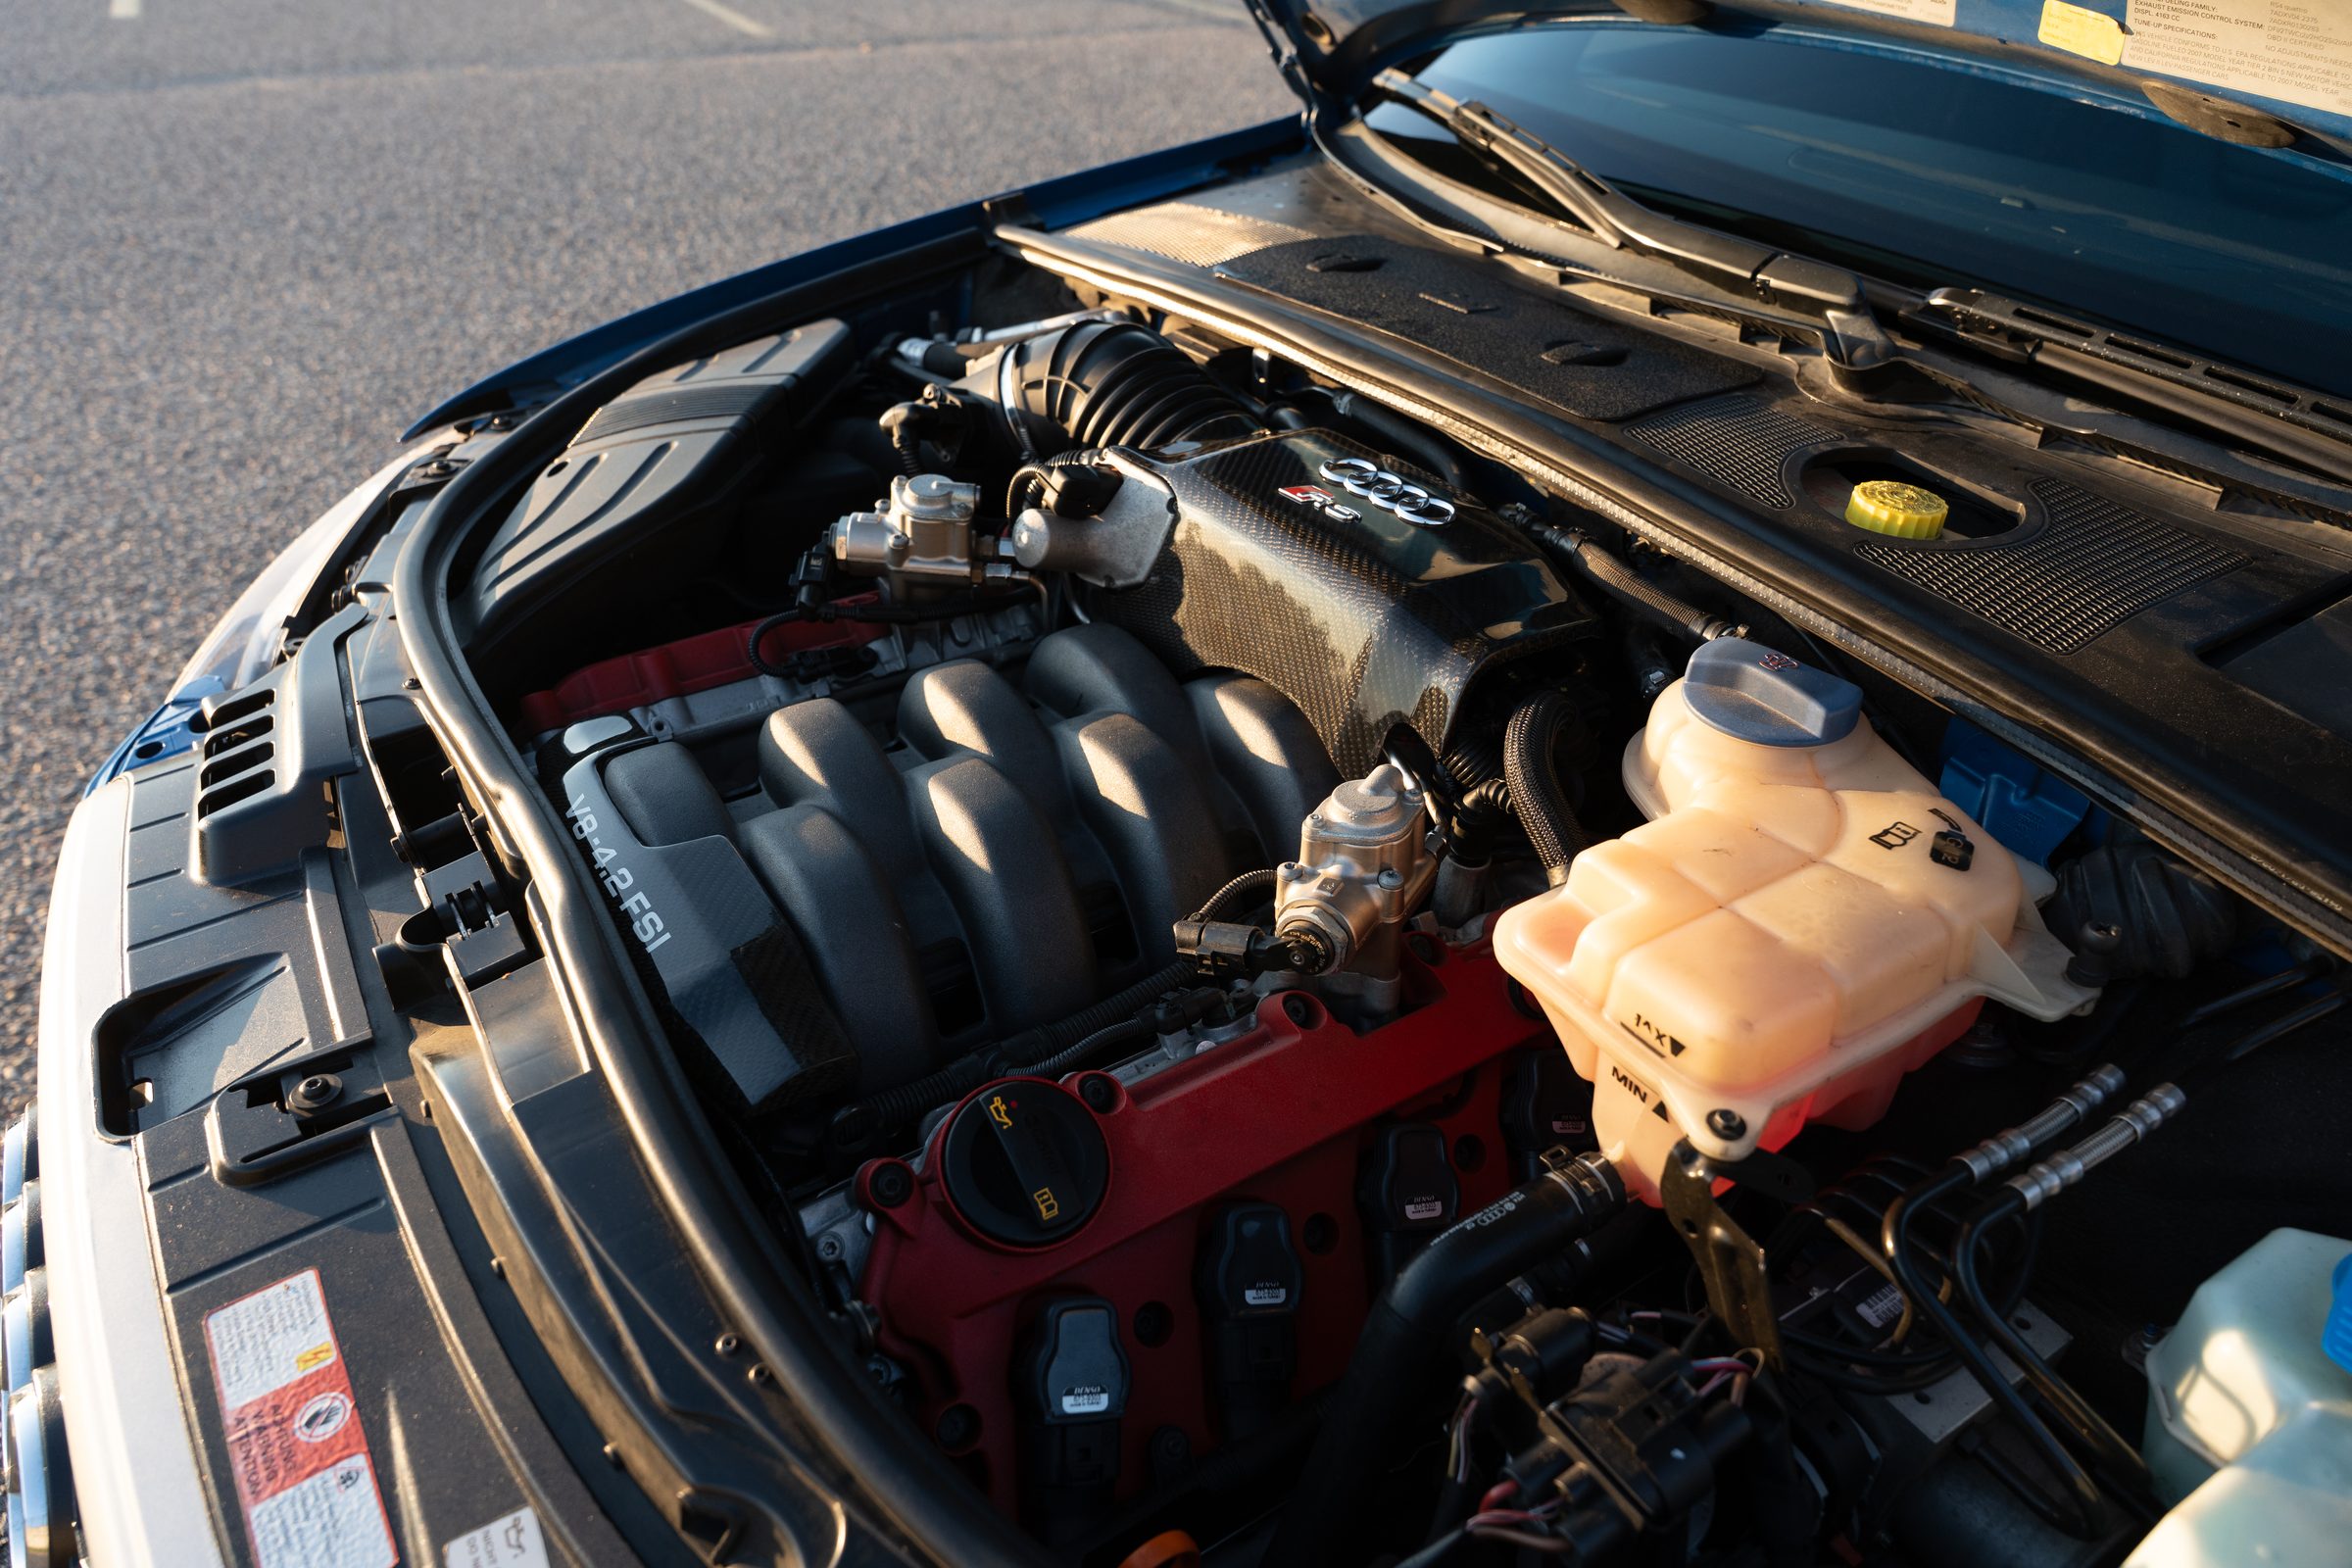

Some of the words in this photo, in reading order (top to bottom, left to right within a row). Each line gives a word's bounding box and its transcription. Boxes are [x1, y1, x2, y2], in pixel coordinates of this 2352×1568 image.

[2134, 0, 2165, 10] EXHAUST
[2166, 6, 2199, 17] EMISSION
[2200, 12, 2232, 24] CONTROL
[2234, 19, 2265, 29] SYSTEM:
[2131, 37, 2162, 48] GASOLINE
[2163, 44, 2185, 53] FUELED
[2186, 48, 2202, 57] 2007
[2203, 52, 2227, 62] MODEL
[2228, 57, 2244, 66] YEAR
[2286, 70, 2302, 78] NEW
[2303, 74, 2329, 84] MOTOR
[2133, 18, 2162, 28] TUNE-UP
[2163, 24, 2218, 39] SPECIFICATIONS:
[2277, 47, 2328, 62] ADJUSTMENTS
[2147, 32, 2173, 41] VEHICLE
[2174, 38, 2210, 50] CONFORMS
[2249, 54, 2296, 68] REGULATIONS
[2297, 64, 2338, 76] APPLICABLE
[2289, 38, 2325, 50] CERTIFIED
[2144, 47, 2180, 60] CALIFORNIA
[2181, 56, 2226, 70] REGULATIONS
[2226, 66, 2265, 78] APPLICABLE
[2294, 80, 2318, 90] MODEL
[2320, 86, 2339, 95] YEAR
[2174, 63, 2210, 74] PASSENGER
[2211, 71, 2229, 79] CARS
[619, 891, 671, 953] FSI
[1612, 1066, 1647, 1102] MIN
[1074, 1386, 1101, 1395] DENSO
[232, 1415, 261, 1496] ATTENTION
[251, 1408, 278, 1484] WARNING
[270, 1402, 296, 1473] ACHTUNG
